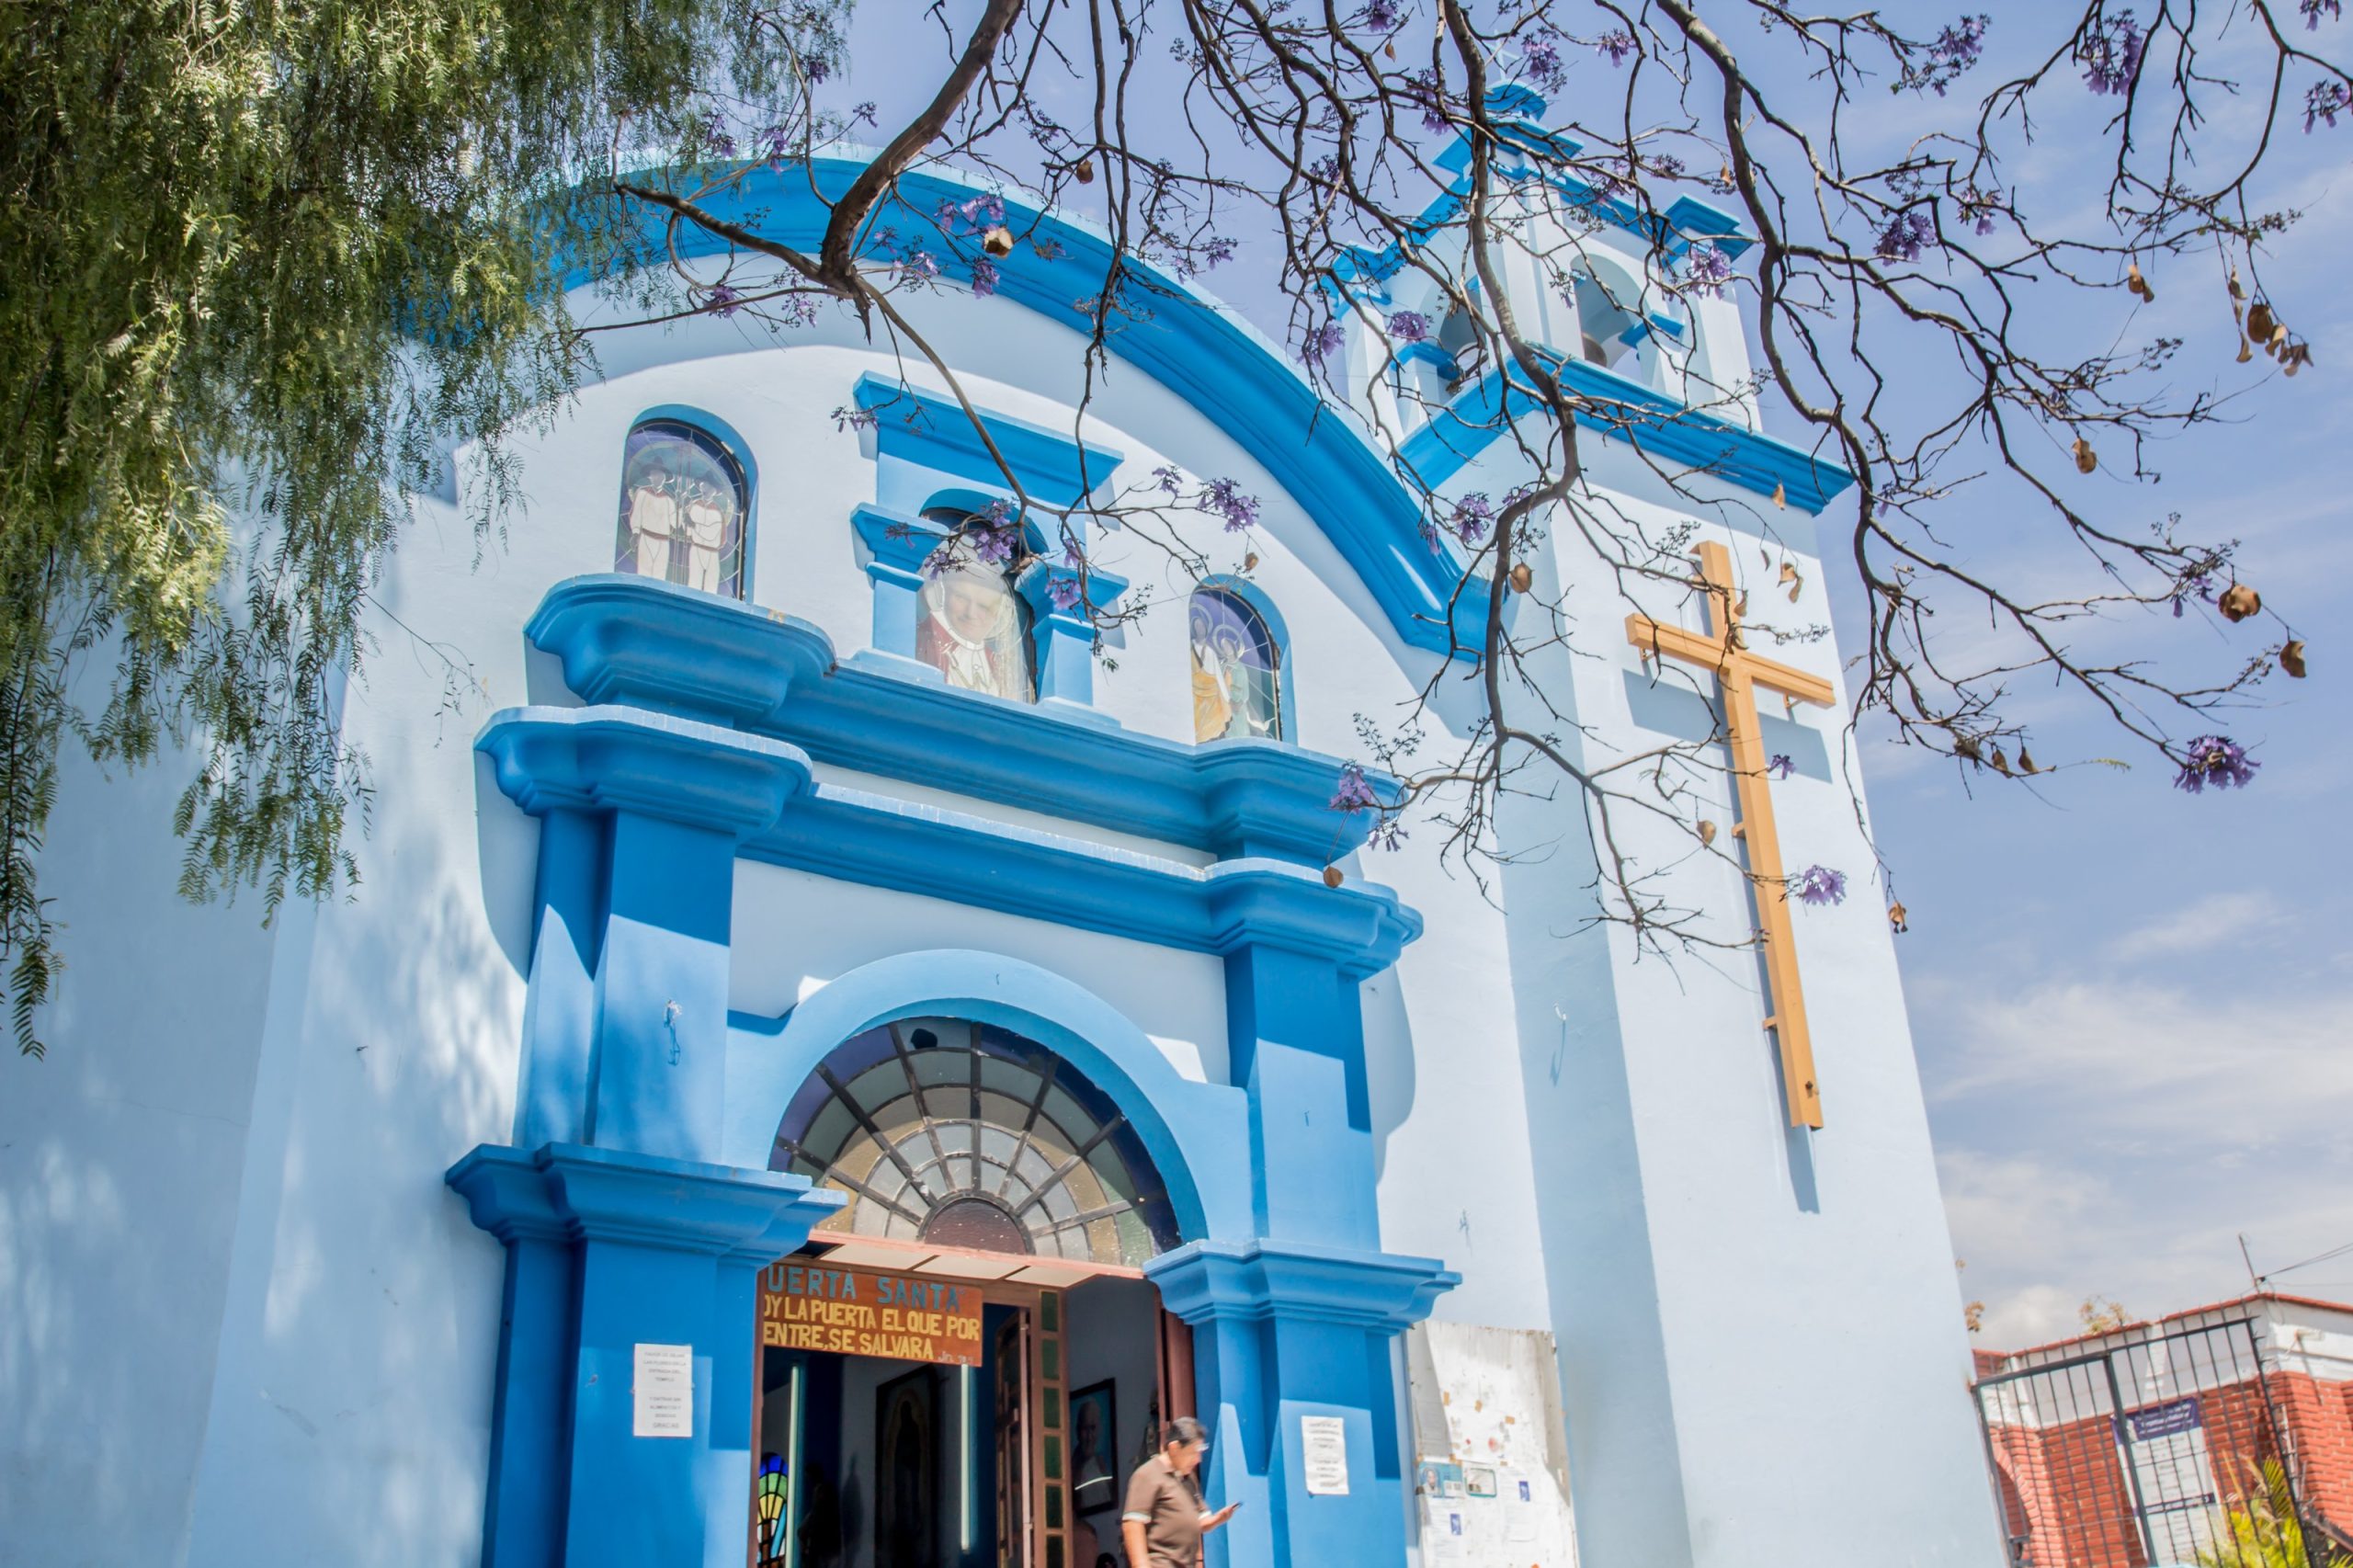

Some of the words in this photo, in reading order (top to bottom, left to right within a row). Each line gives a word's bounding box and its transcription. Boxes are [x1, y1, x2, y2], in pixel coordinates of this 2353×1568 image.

[877, 1277, 959, 1312] SANTA
[881, 1308, 905, 1332] EL
[906, 1310, 942, 1336] QUE
[946, 1314, 980, 1341] POR
[858, 1332, 934, 1360] SALVARA
